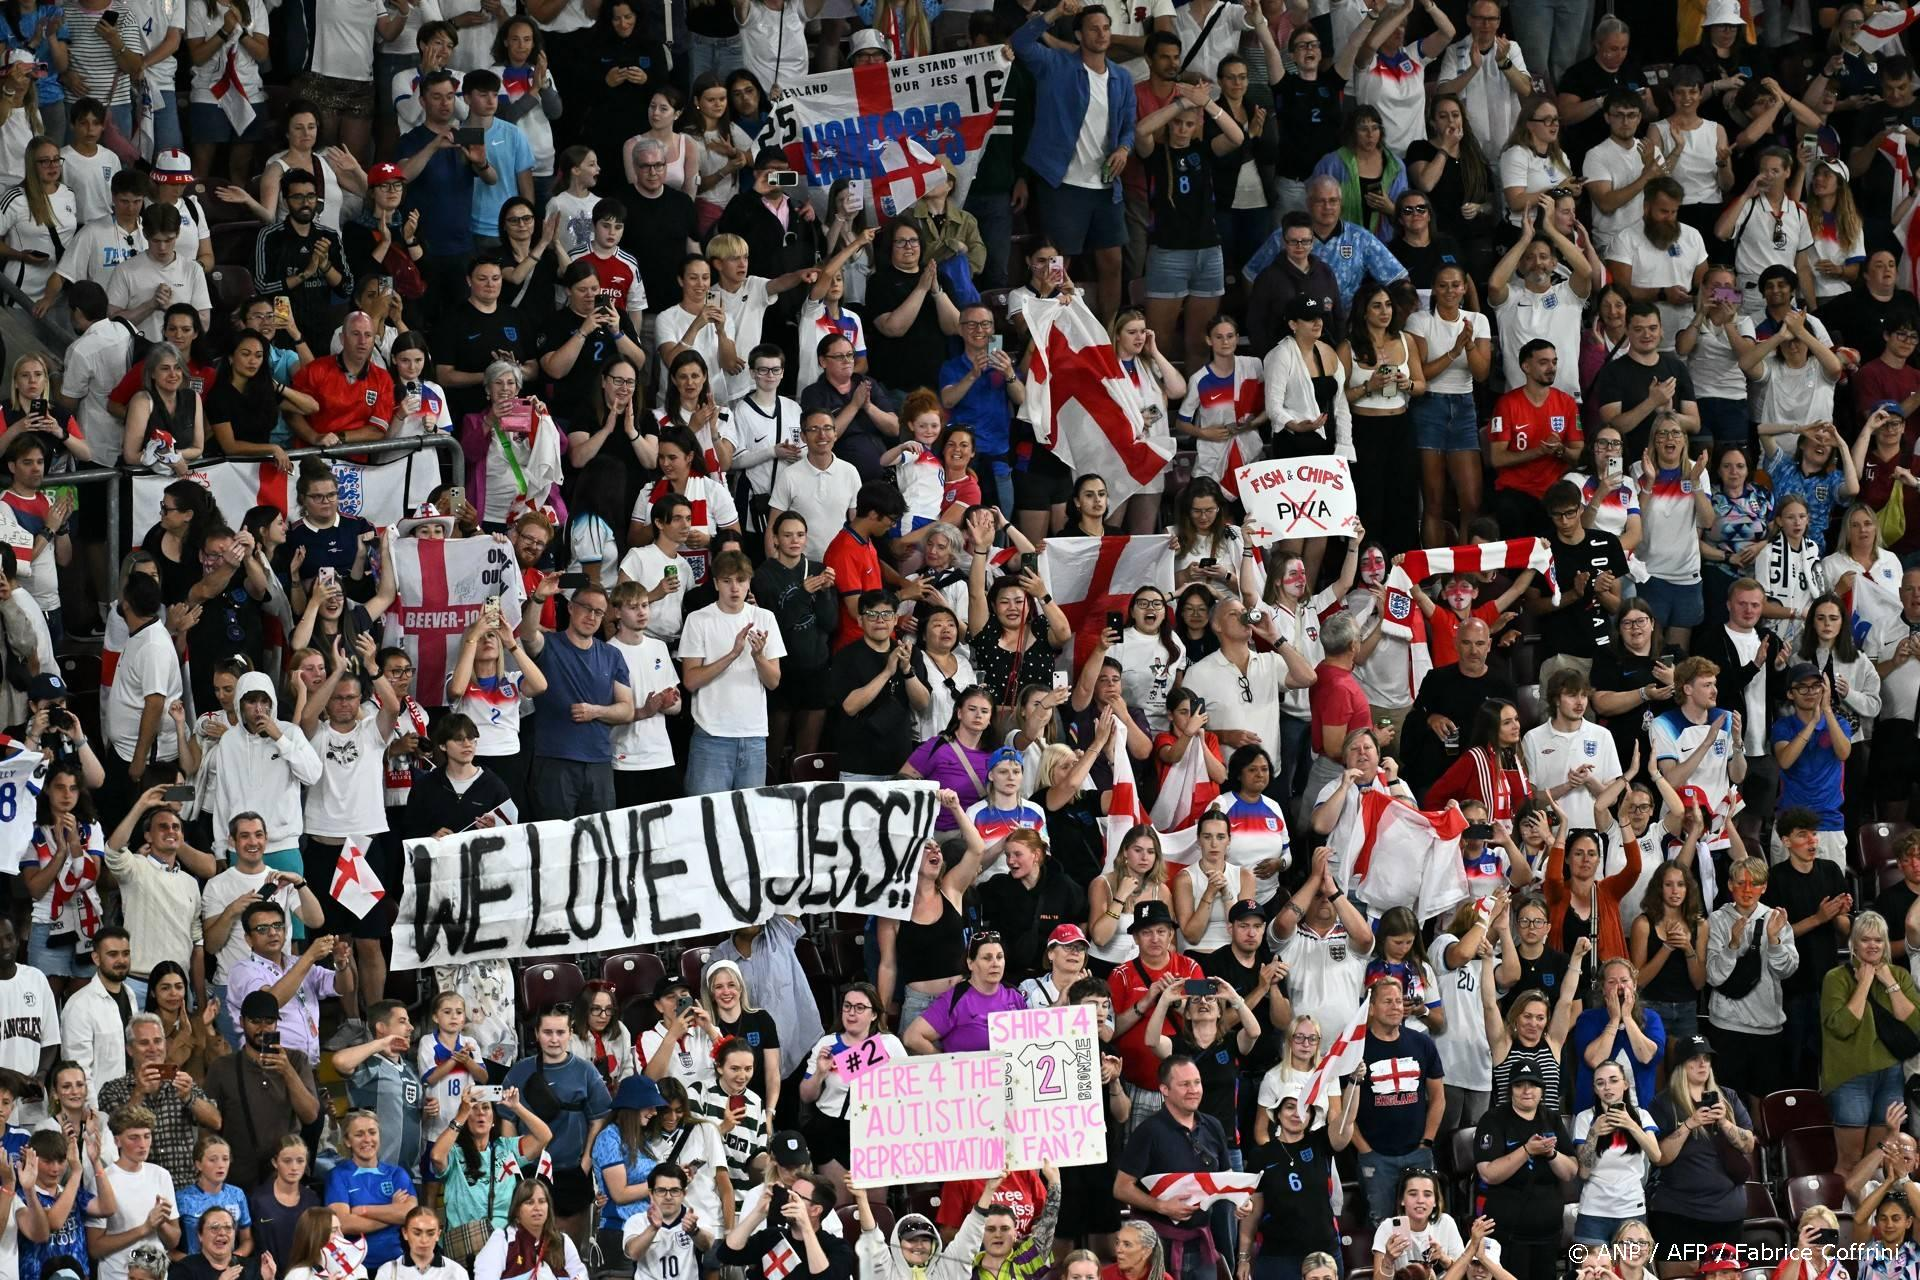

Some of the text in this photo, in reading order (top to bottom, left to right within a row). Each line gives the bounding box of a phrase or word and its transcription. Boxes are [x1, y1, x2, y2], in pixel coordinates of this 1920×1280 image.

[891, 51, 995, 78] WE STAND WITH
[779, 84, 828, 101] ERLAND
[894, 74, 958, 93] OUR JESS
[757, 103, 797, 149] 25
[1311, 108, 1321, 123] 2
[1179, 175, 1190, 194] 8
[594, 341, 604, 361] 2
[1516, 431, 1528, 451] 6
[1250, 469, 1285, 494] FISH
[1297, 465, 1344, 491] CHIPS
[490, 707, 502, 725] 2
[412, 782, 936, 963] WE LOVE U JESS!!
[993, 1007, 1091, 1043] SHIRT 4
[846, 1039, 884, 1073] #2
[1075, 1038, 1092, 1101] BRONZE
[447, 1078, 461, 1097] 18
[858, 1056, 1002, 1101] HERE 4 THE
[1036, 1055, 1062, 1095] 2
[866, 1097, 994, 1138] AUTISTIC
[1004, 1103, 1102, 1134] AUTISTIC
[853, 1137, 1005, 1180] REPRESENTATION
[1023, 1130, 1086, 1162] FAN?
[1288, 1172, 1302, 1191] 6
[659, 1254, 679, 1275] 10
